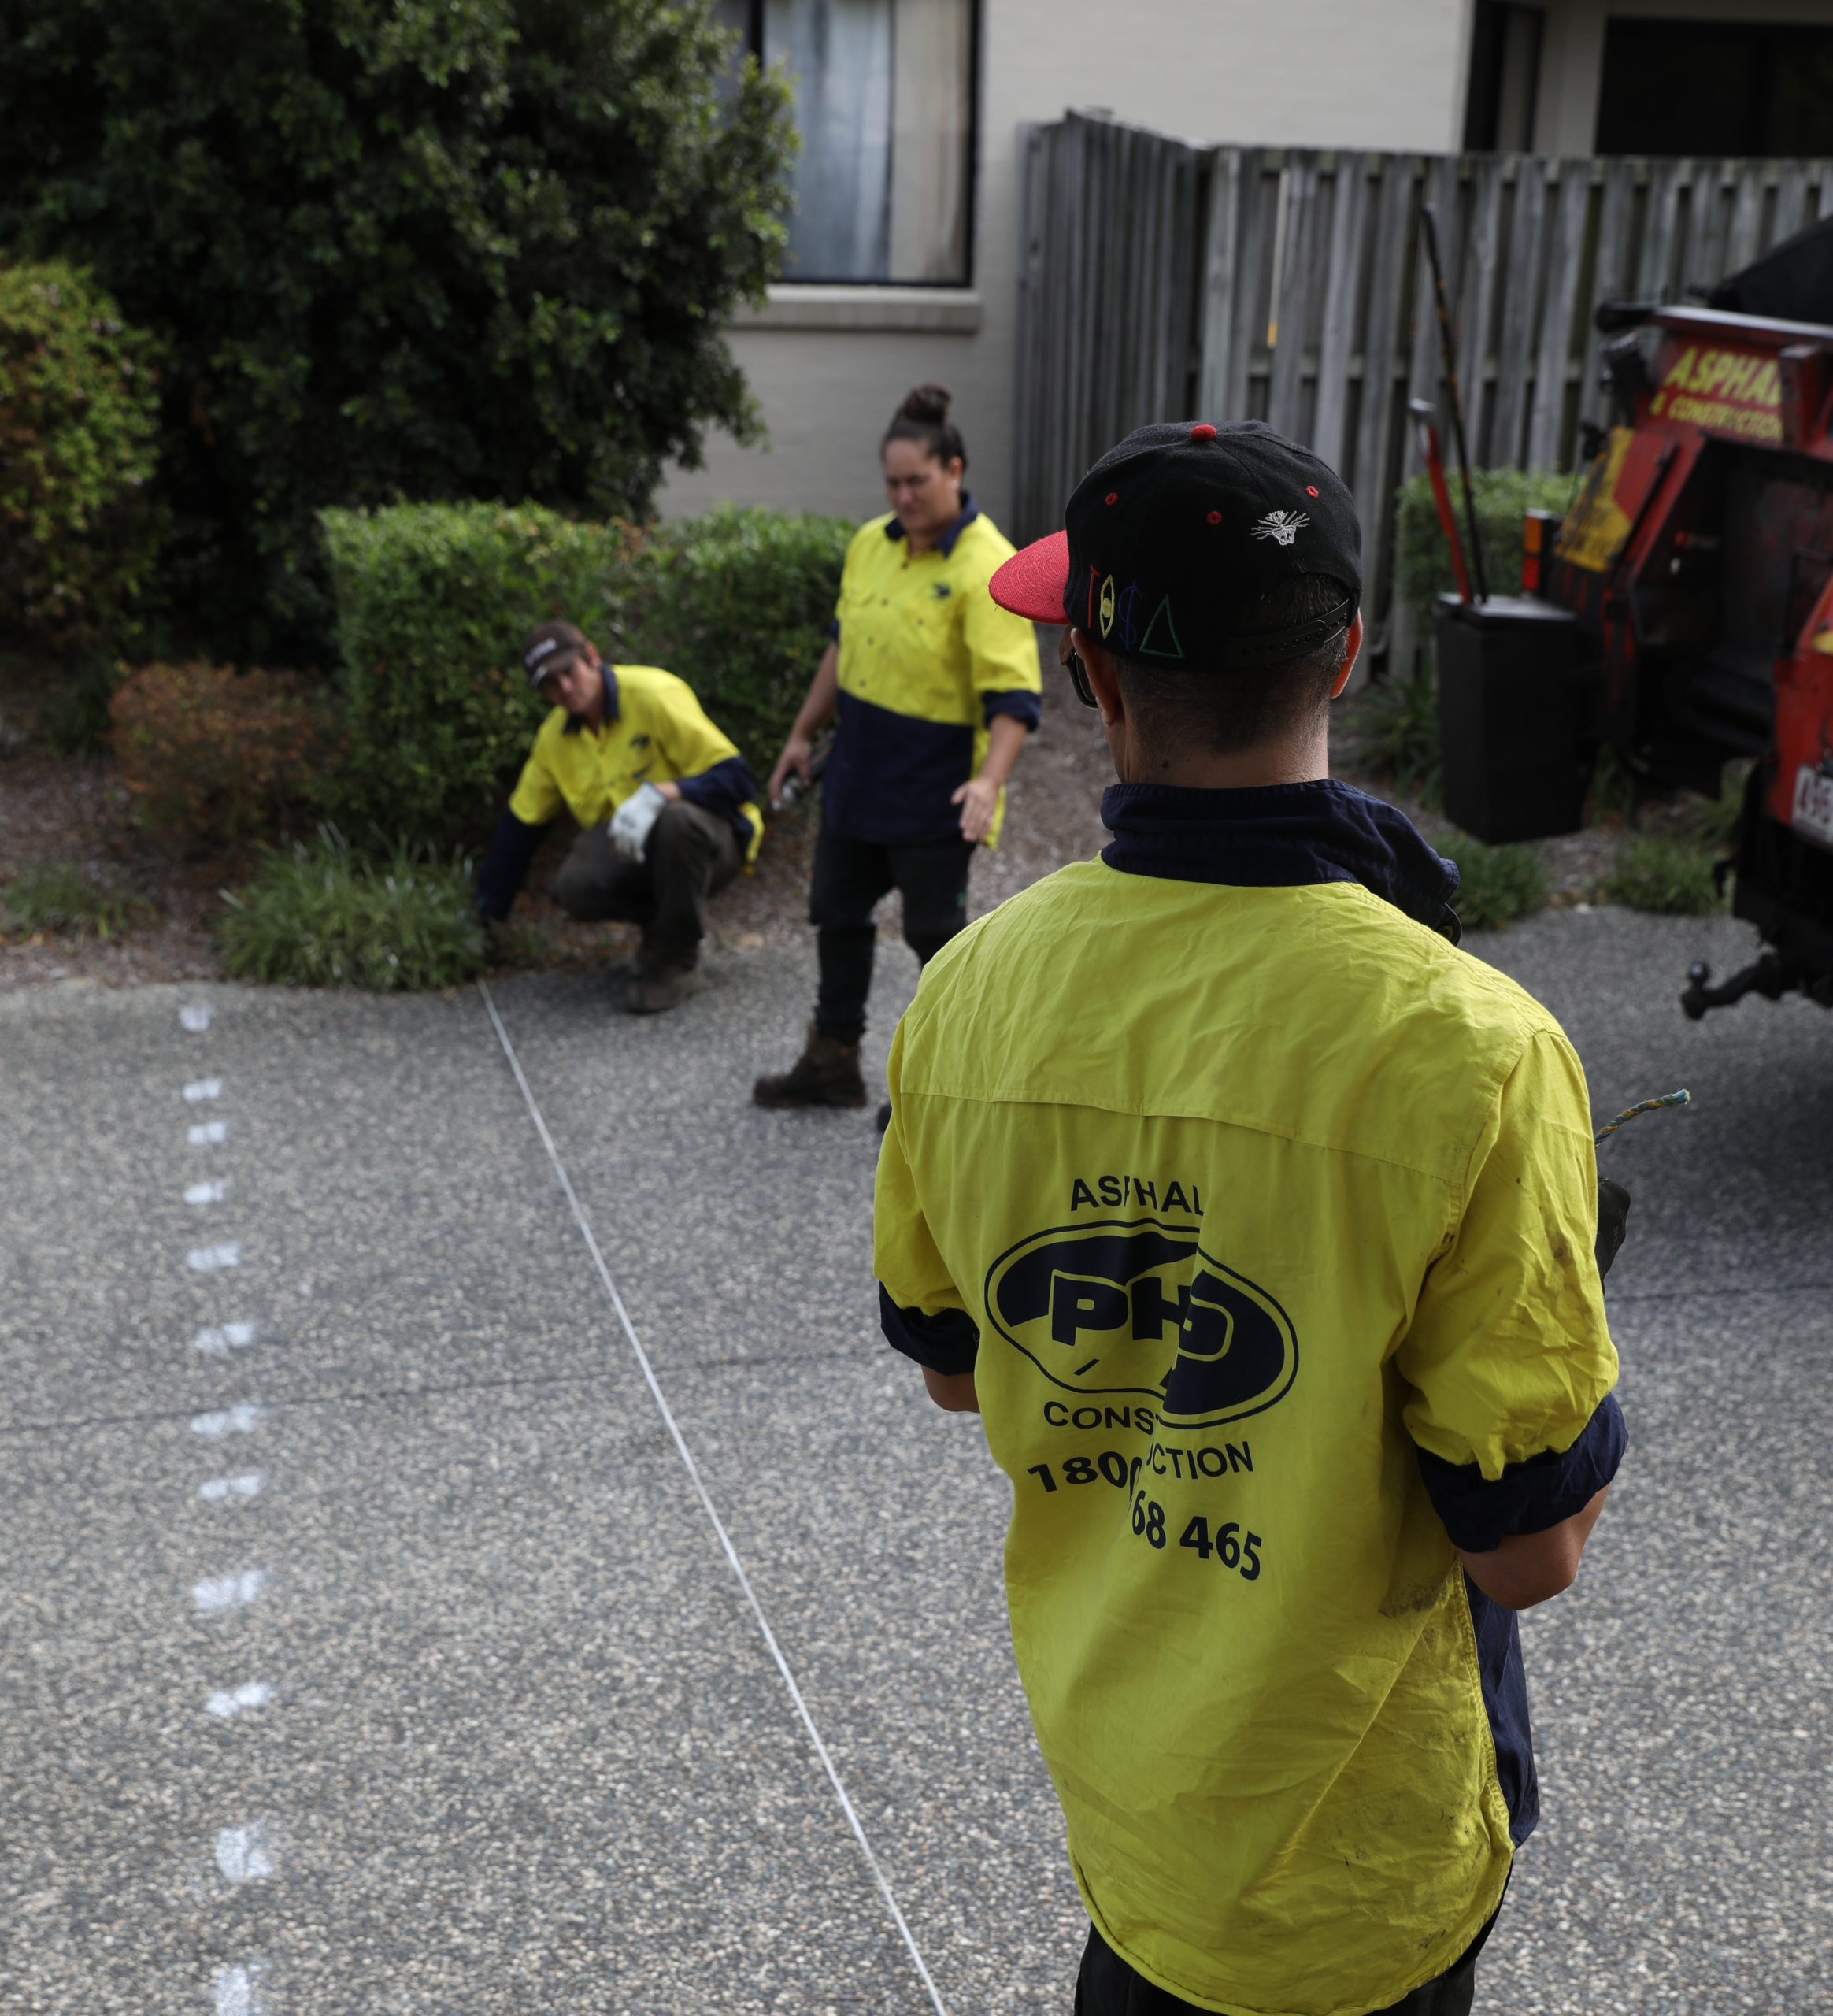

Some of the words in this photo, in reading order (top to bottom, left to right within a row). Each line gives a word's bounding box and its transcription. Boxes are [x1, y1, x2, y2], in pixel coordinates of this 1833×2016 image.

[1665, 346, 1782, 407] ASPHAL
[1071, 1175, 1204, 1217] ASHAL
[1043, 1401, 1253, 1480] CONSCTION
[1028, 1451, 1143, 1500] 1800
[1129, 1489, 1166, 1550] 68
[1179, 1515, 1262, 1581] 465
